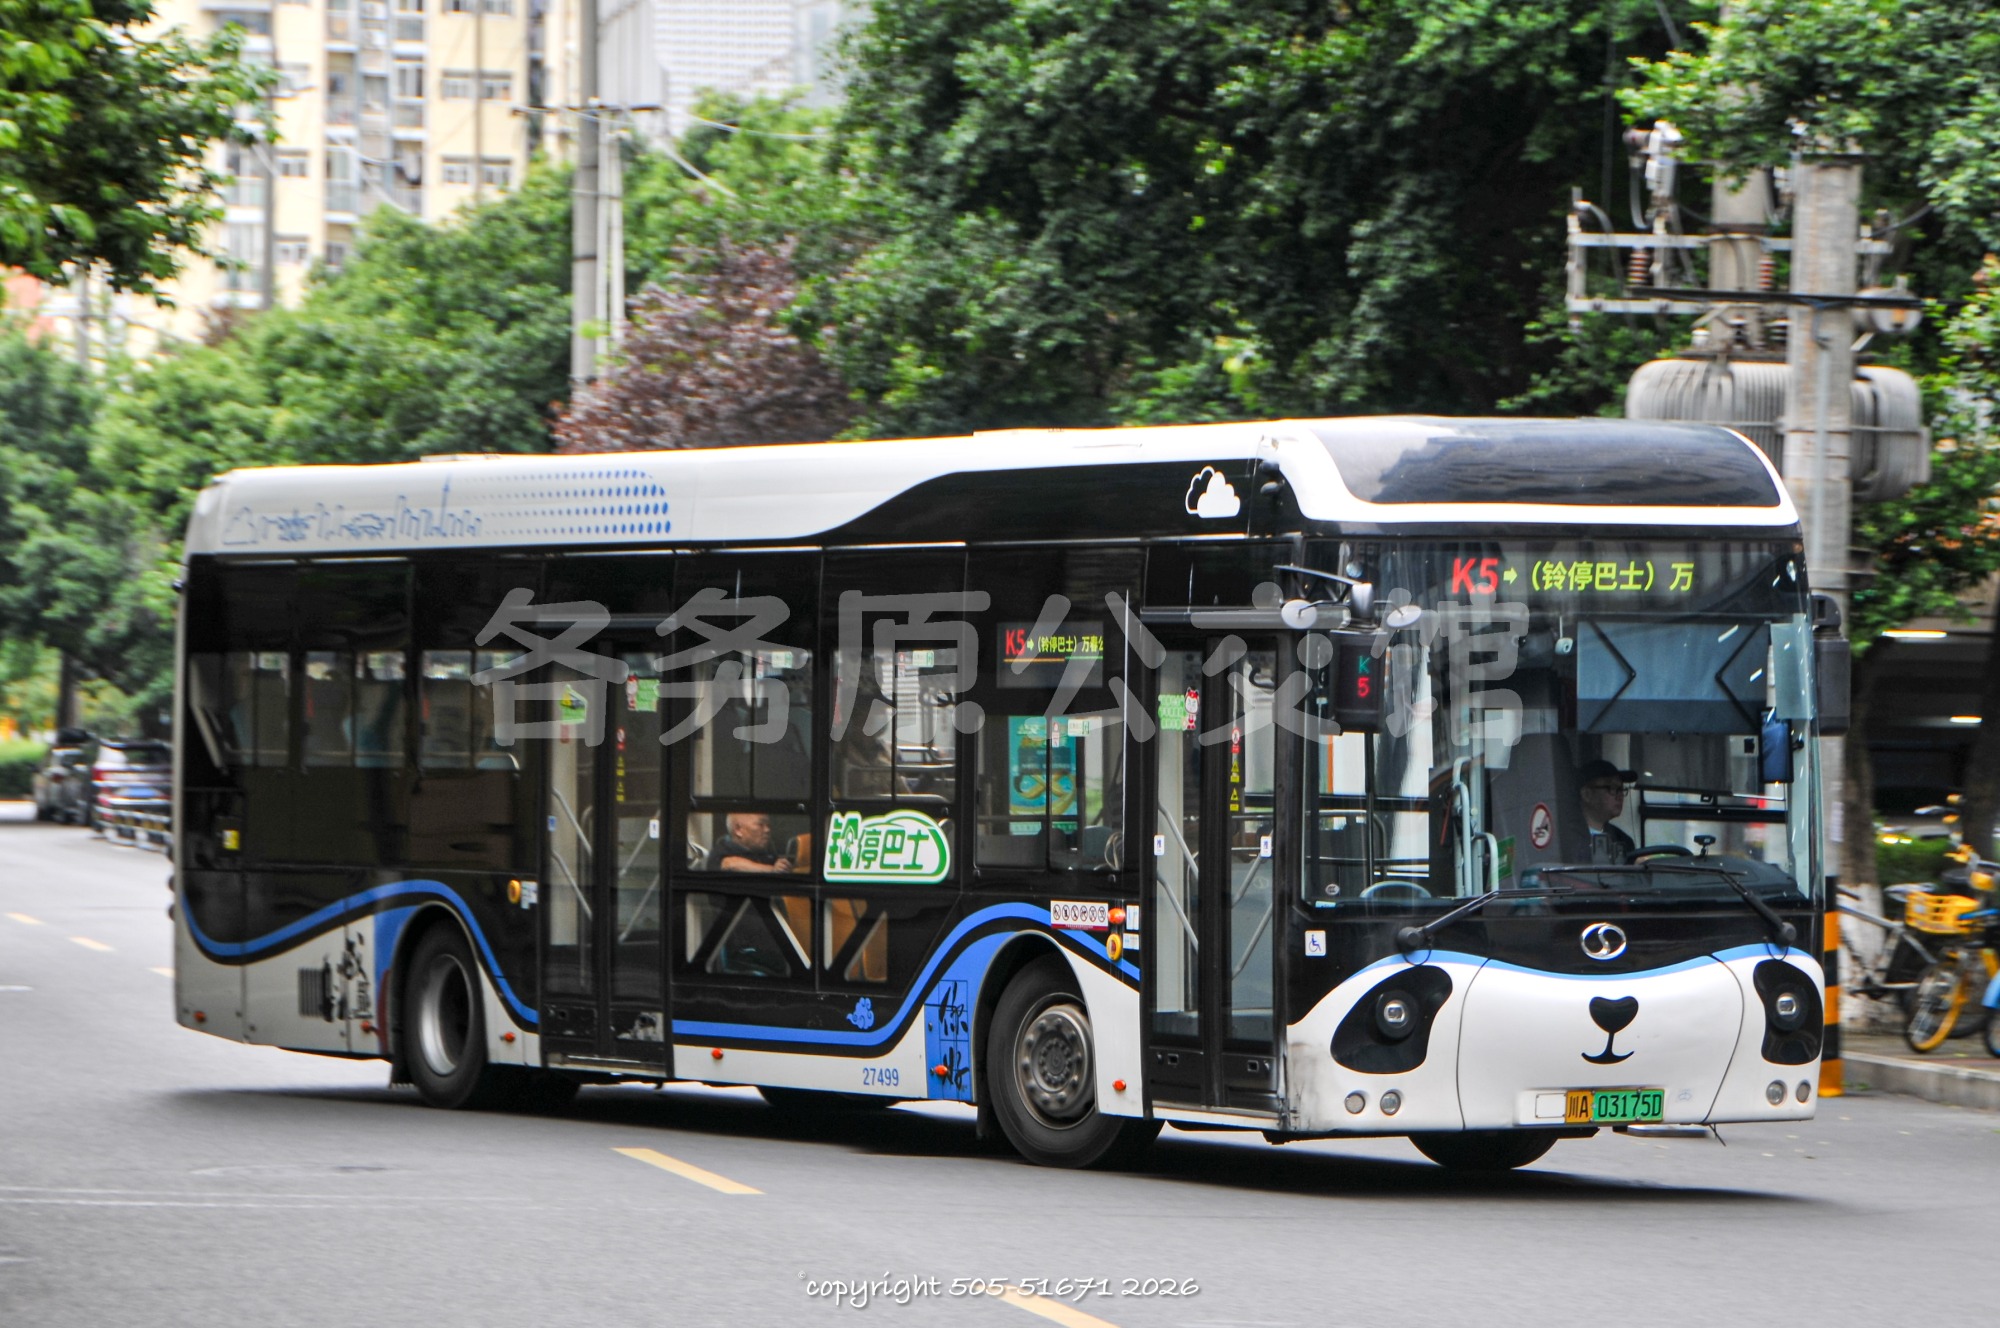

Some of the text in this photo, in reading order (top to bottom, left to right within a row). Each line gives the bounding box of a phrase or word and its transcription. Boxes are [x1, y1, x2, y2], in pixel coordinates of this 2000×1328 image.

[1451, 557, 1499, 595] K5
[1005, 629, 1026, 655] K5
[828, 817, 930, 870] 铃停巴士
[862, 1067, 899, 1087] 27499
